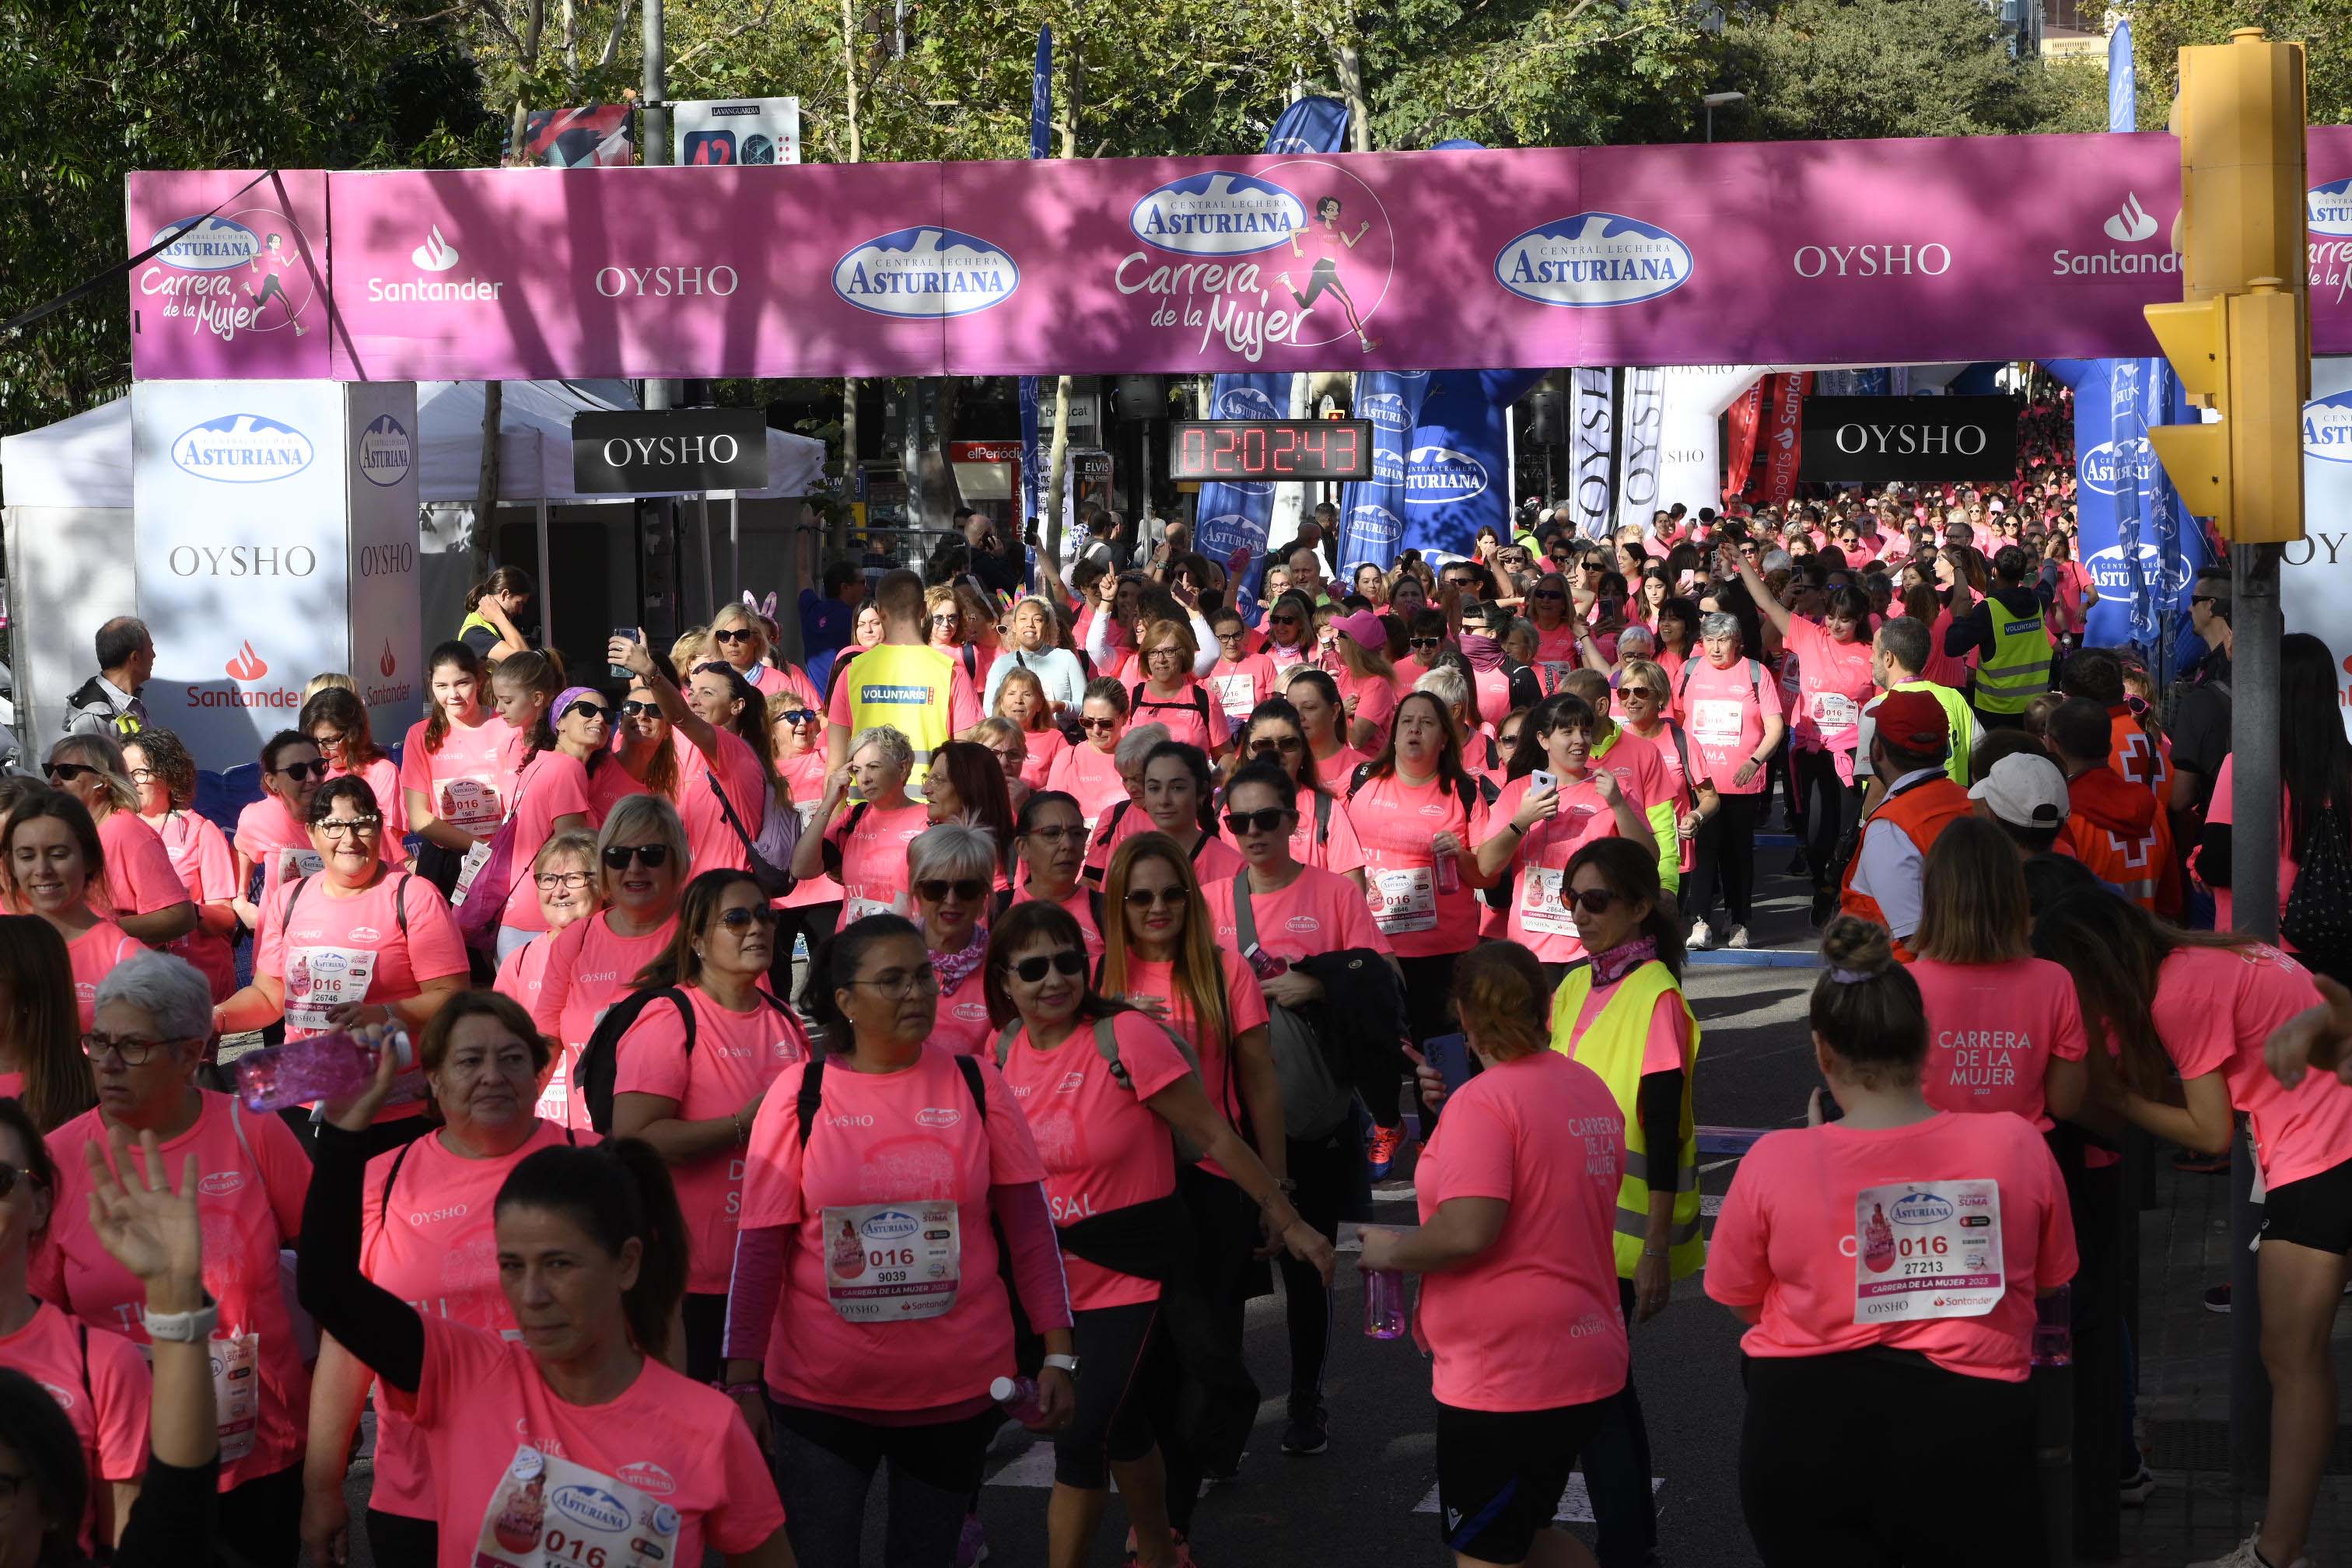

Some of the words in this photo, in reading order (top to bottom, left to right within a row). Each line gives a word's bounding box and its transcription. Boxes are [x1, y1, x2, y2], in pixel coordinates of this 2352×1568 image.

[1171, 201, 1226, 209] CENTRAL
[1232, 199, 1288, 208] LECHERA
[1143, 203, 1292, 234] ASTURIANA
[1540, 245, 1603, 255] CENTRAL
[1608, 243, 1671, 254] LECHERA
[876, 257, 934, 268] CENTRAL
[940, 257, 999, 267] LECHERA
[1510, 249, 1678, 283] ASTURIANA
[1794, 243, 1951, 277] OYSHO
[2053, 249, 2185, 275] Santand
[141, 267, 231, 296] Carrera
[596, 265, 738, 297] OYSHO
[847, 261, 1004, 294] ASTURIANA
[1115, 251, 1260, 295] Carrera
[369, 278, 502, 302] Santander
[163, 297, 180, 317] de
[184, 297, 196, 317] la
[194, 292, 266, 341] Mujer
[1150, 297, 1177, 327] de
[1183, 294, 1202, 327] la
[1199, 289, 1314, 362] Mujer
[1836, 423, 1986, 455] OYSHO
[183, 440, 303, 466] ASTURIANA
[363, 440, 408, 469] ASTURIANA
[604, 435, 738, 467] OYSHO
[1183, 429, 1356, 471] 02:02:43
[1085, 463, 1109, 472] ELVIS
[170, 546, 316, 576] OYSHO
[361, 542, 412, 576] OYSHO
[2005, 621, 2041, 632] VOLUNTARIS
[367, 682, 411, 708] Santander
[863, 689, 926, 700] VOLUNTARIS
[457, 800, 479, 810] 016
[1386, 895, 1410, 905] 016
[313, 958, 346, 968] ASTURIANA
[313, 978, 341, 991] 016
[579, 971, 616, 984] OYSHO
[315, 994, 338, 1003] 26746
[288, 1013, 316, 1023] OYSHO
[1937, 1031, 2032, 1050] CARRERA
[1955, 1049, 1979, 1067] DE
[1986, 1049, 2013, 1068] LA
[1949, 1067, 2015, 1087] MUJER
[1568, 1117, 1622, 1137] CARRERA
[1584, 1138, 1599, 1155] DE
[1601, 1136, 1615, 1153] LA
[1586, 1156, 1616, 1176] MUJER
[410, 1204, 468, 1227] OYSHO
[1895, 1206, 1948, 1219] ASTURIANA
[866, 1223, 915, 1235] ASTURIANA
[1899, 1235, 1948, 1257] 016
[870, 1248, 914, 1266] 016
[878, 1271, 906, 1283] 9039
[1905, 1261, 1944, 1275] 27213
[1871, 1283, 1907, 1293] CARRERA
[1908, 1281, 1920, 1290] DE
[1922, 1279, 1934, 1288] LA
[1935, 1278, 1965, 1287] MUJER
[1969, 1277, 1990, 1286] 2023
[840, 1305, 880, 1314] OYSHO
[1867, 1300, 1909, 1315] OYSHO
[1946, 1297, 1993, 1307] Santander
[1570, 1320, 1605, 1339] OYSHO
[558, 1492, 624, 1529] ASTURIANA
[545, 1529, 607, 1568] 016
